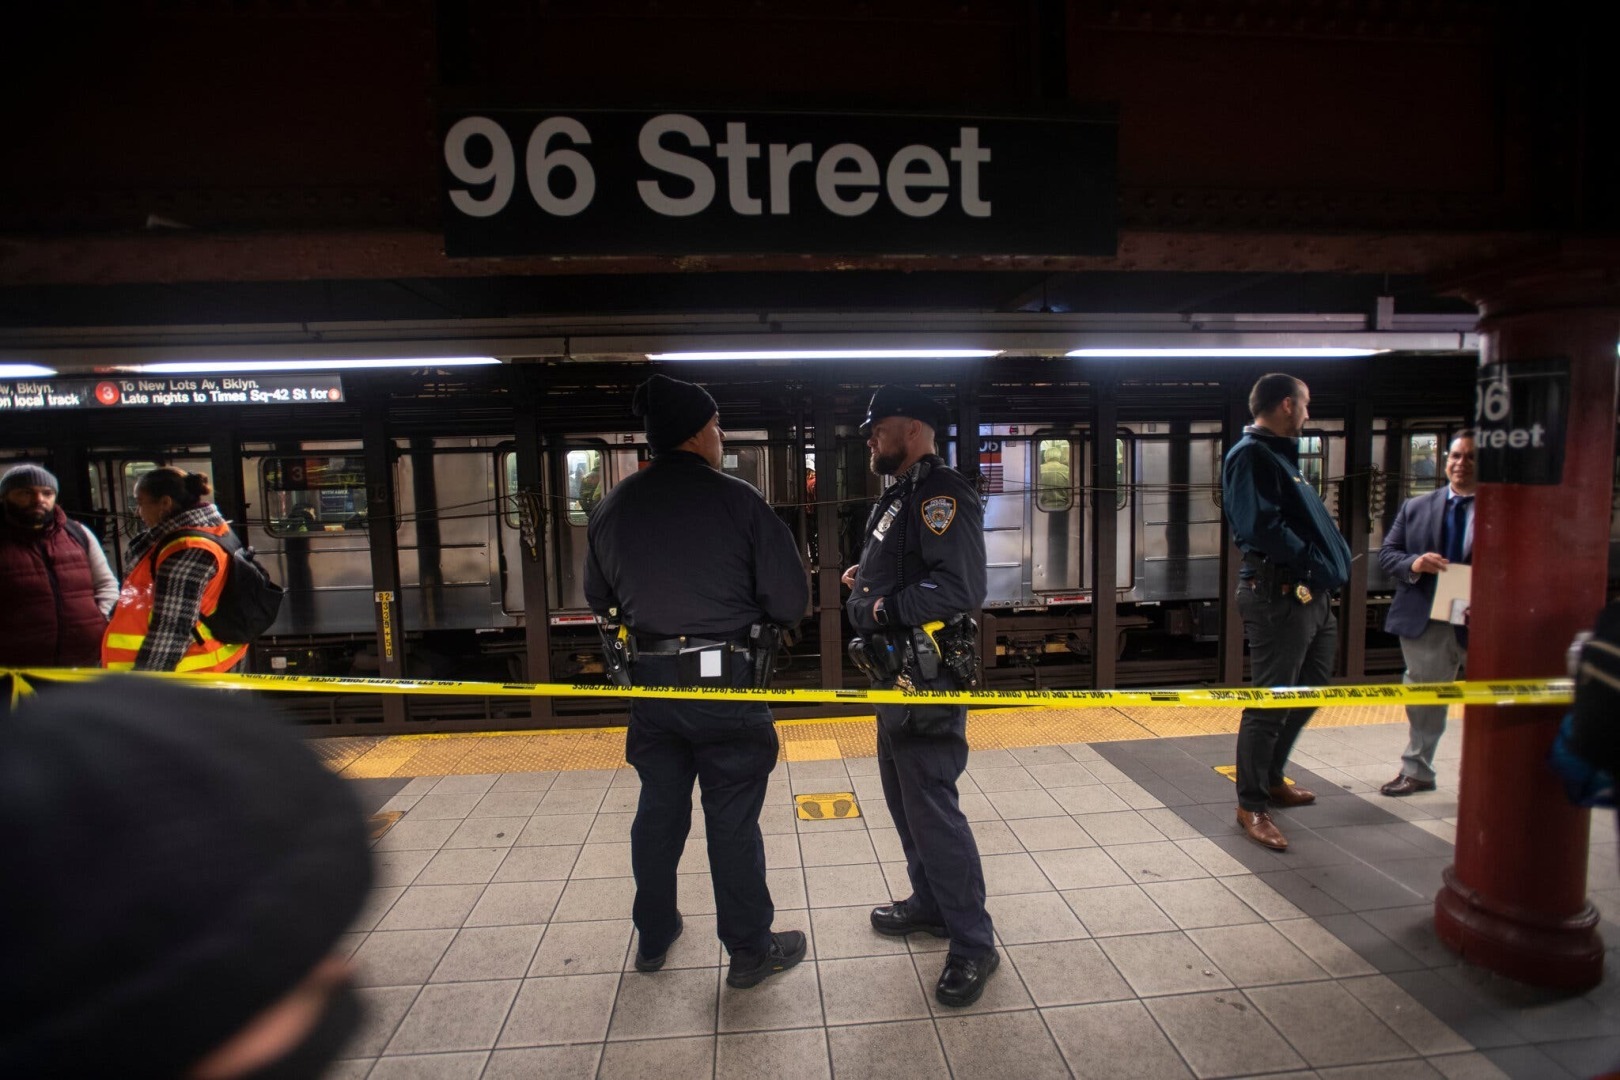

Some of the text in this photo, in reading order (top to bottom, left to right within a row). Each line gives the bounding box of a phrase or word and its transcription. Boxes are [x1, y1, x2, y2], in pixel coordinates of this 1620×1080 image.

[444, 112, 993, 218] 96 Street
[17, 382, 54, 395] Bklyn.
[120, 377, 259, 392] To New Lots Av, Bklyn.
[102, 386, 115, 400] 3
[121, 393, 148, 404] Late
[152, 391, 189, 405] nights
[193, 391, 206, 402] to
[209, 390, 247, 403] Times
[250, 388, 290, 403] Sq-42
[293, 388, 307, 400] St
[311, 388, 328, 400] for
[15, 394, 44, 408] local
[48, 393, 80, 405] track
[1474, 424, 1545, 449] treet
[931, 690, 948, 698] NOT
[949, 690, 961, 698] DO
[969, 690, 996, 698] SCENE
